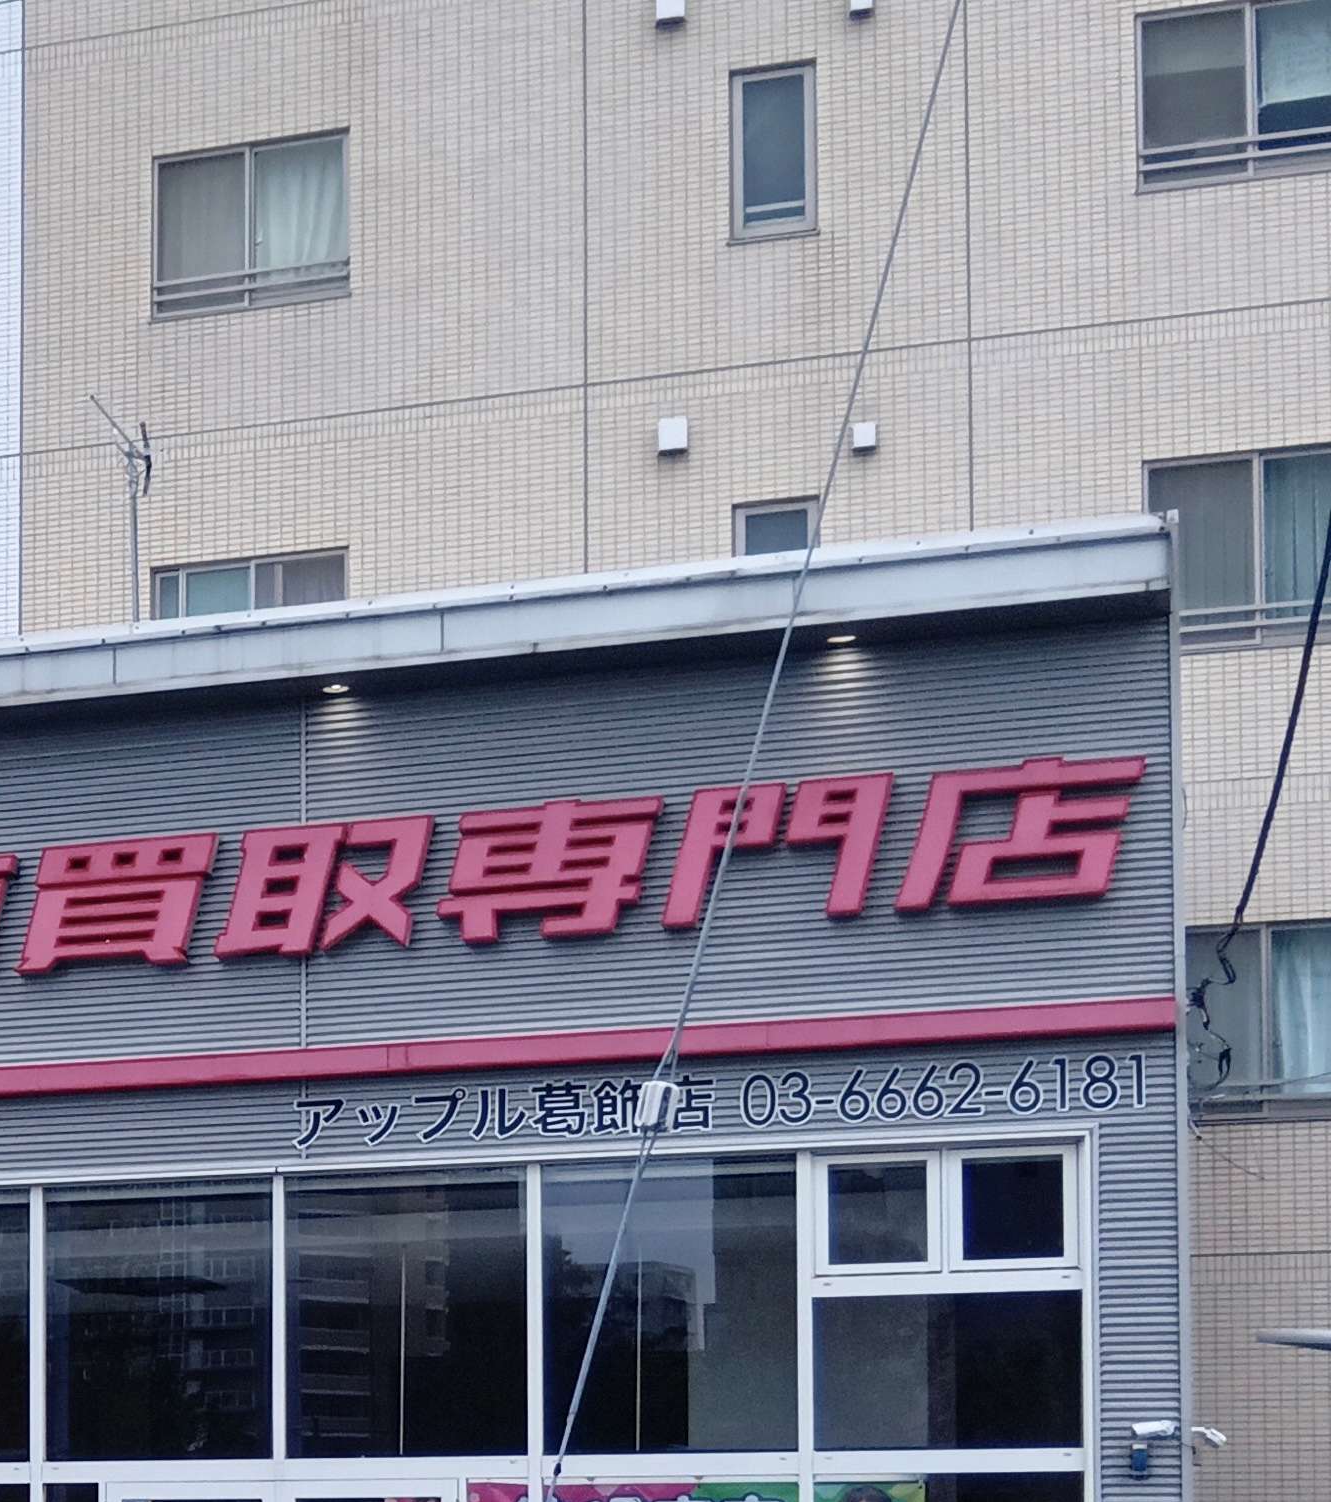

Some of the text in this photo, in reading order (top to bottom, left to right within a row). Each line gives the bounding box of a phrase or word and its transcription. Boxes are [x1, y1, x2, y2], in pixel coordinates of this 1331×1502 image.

[293, 1053, 1147, 1150] アップル葛飾店 03-6662-6181
